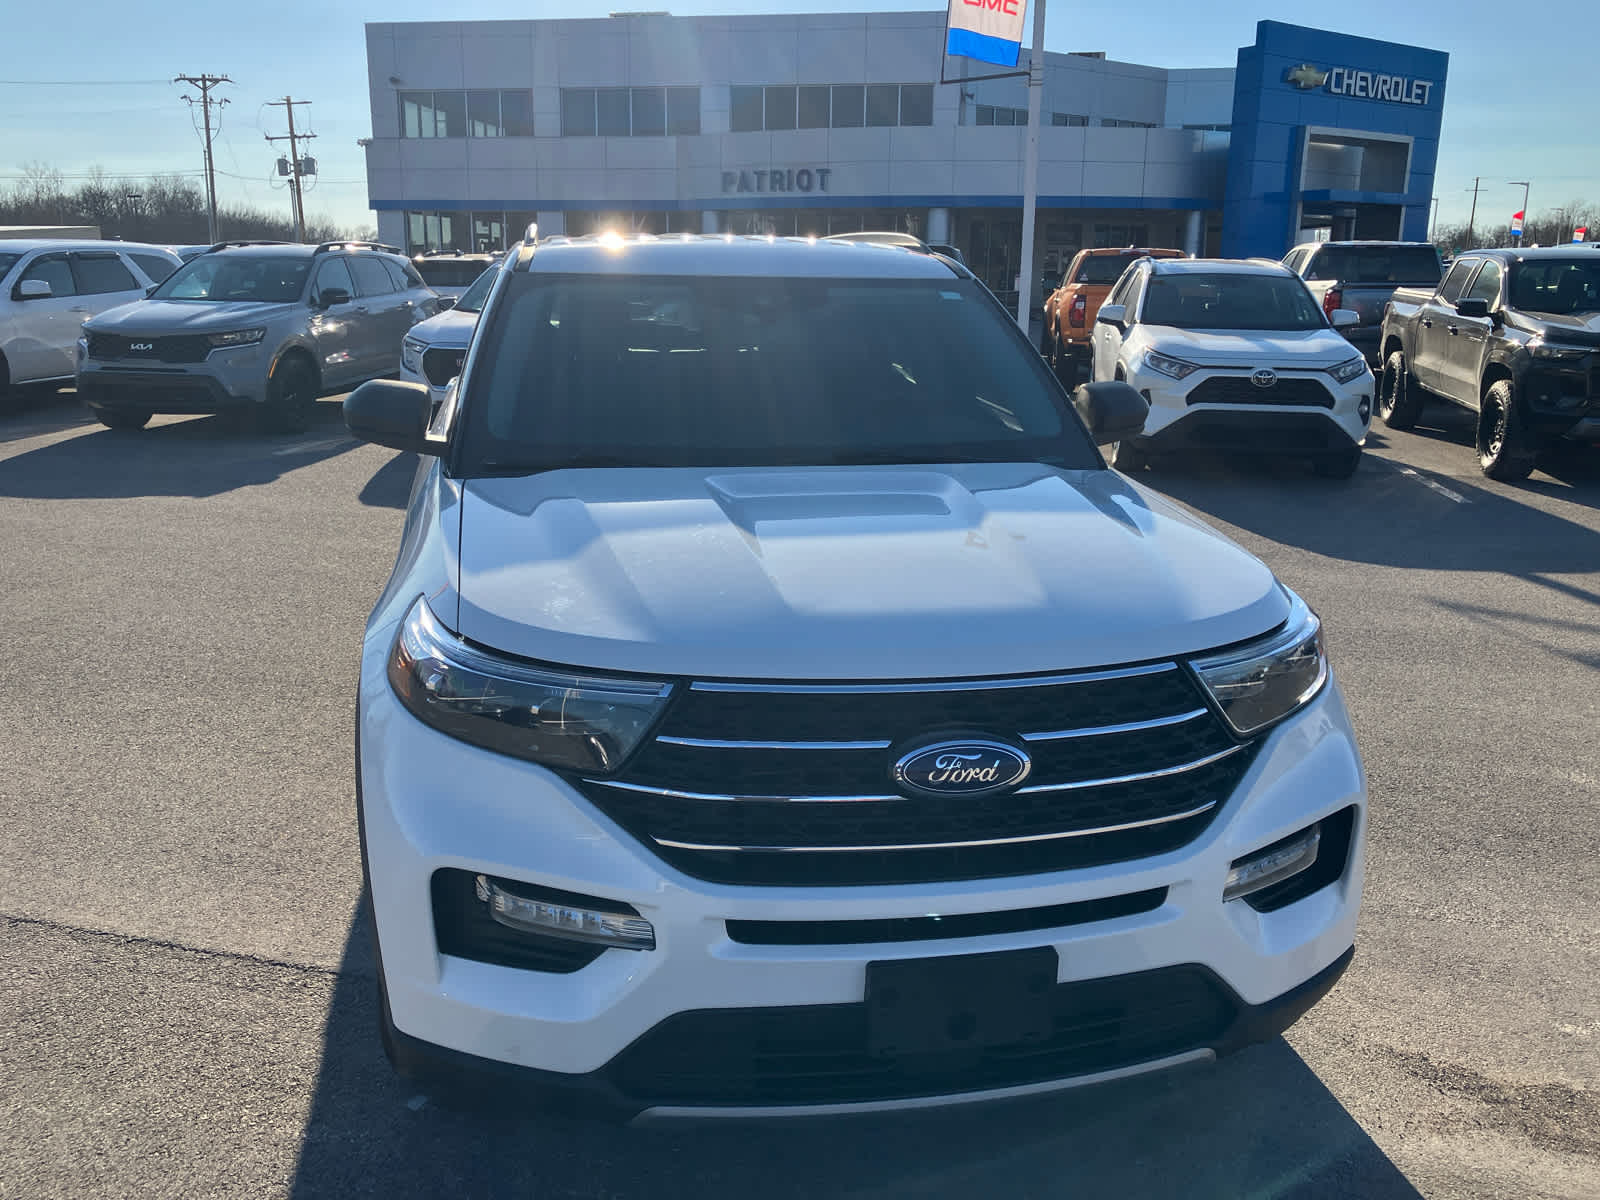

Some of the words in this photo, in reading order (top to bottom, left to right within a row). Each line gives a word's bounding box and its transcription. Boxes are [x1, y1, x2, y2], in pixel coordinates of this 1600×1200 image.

[1330, 67, 1433, 105] CHEVROLET
[721, 168, 832, 193] PATRIOT
[130, 343, 153, 351] KIA
[928, 753, 1001, 783] Ford
